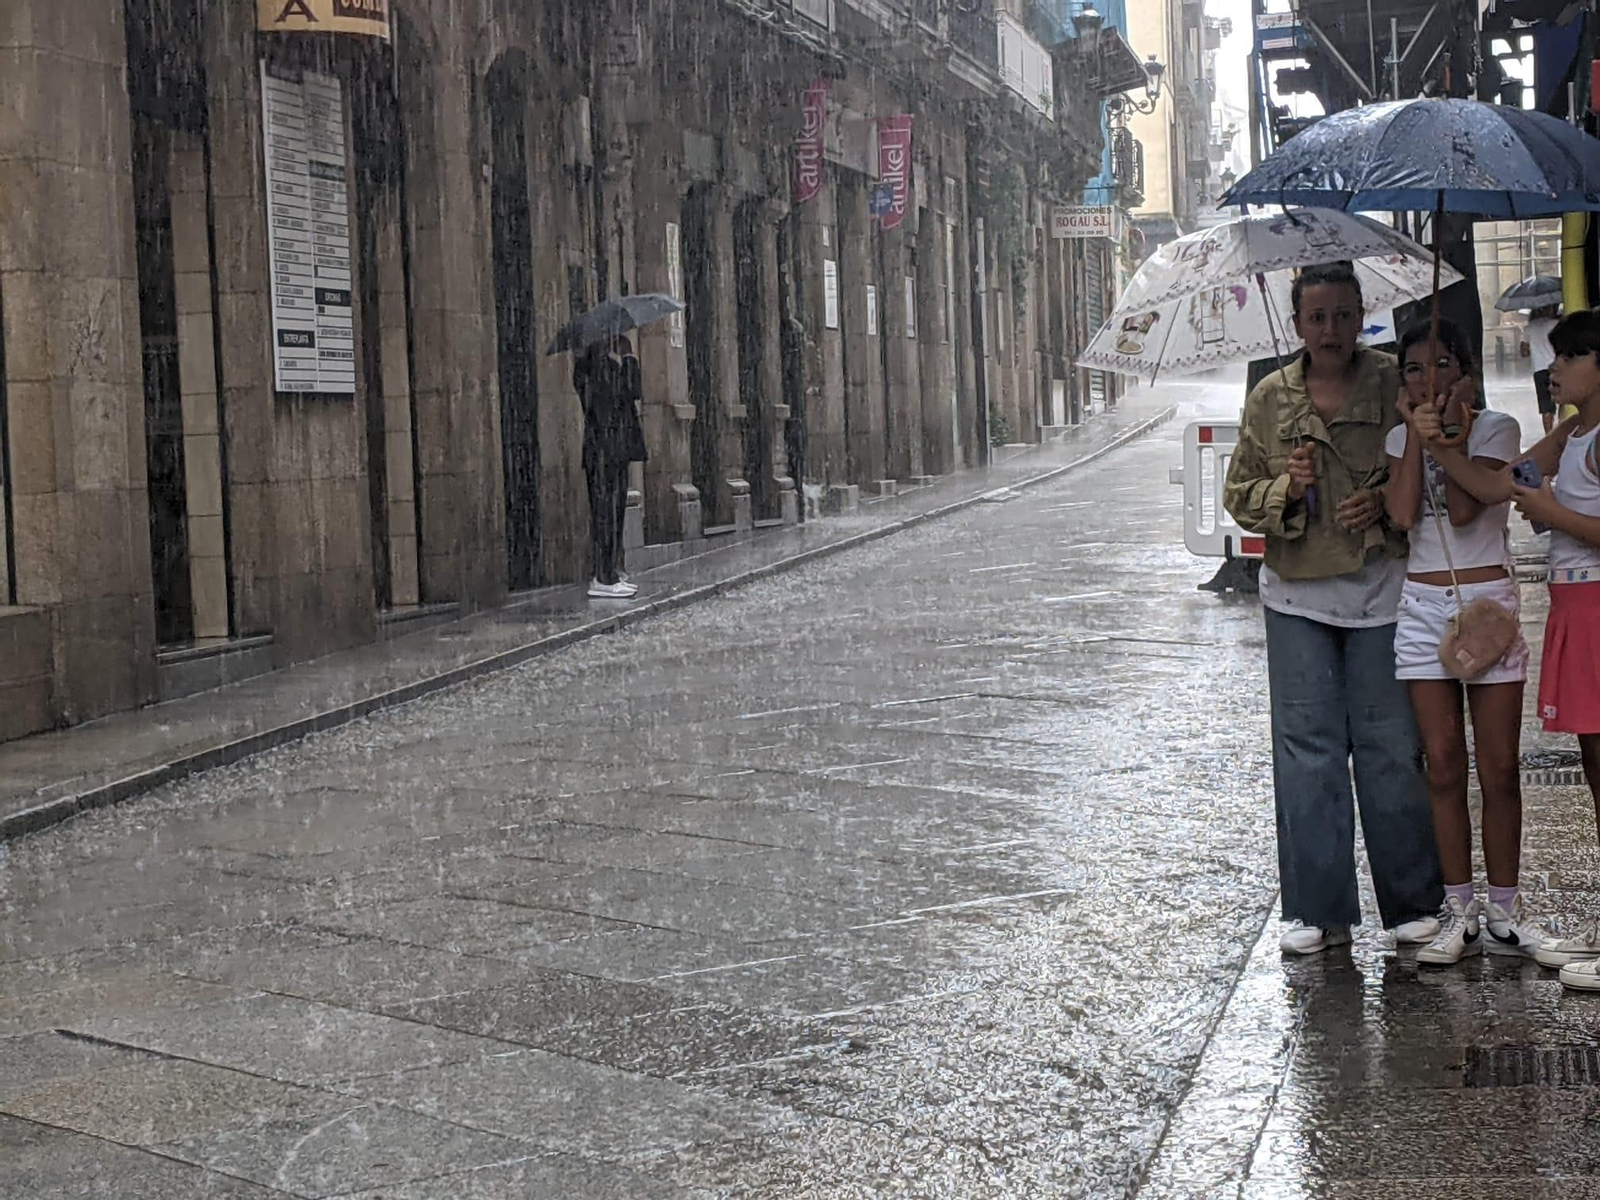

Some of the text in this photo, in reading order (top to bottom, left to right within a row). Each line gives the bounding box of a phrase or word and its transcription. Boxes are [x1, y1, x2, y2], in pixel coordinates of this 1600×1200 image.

[795, 106, 819, 188] artikel
[1054, 207, 1112, 215] PROMOCIONES
[1055, 216, 1091, 228] ROGAU
